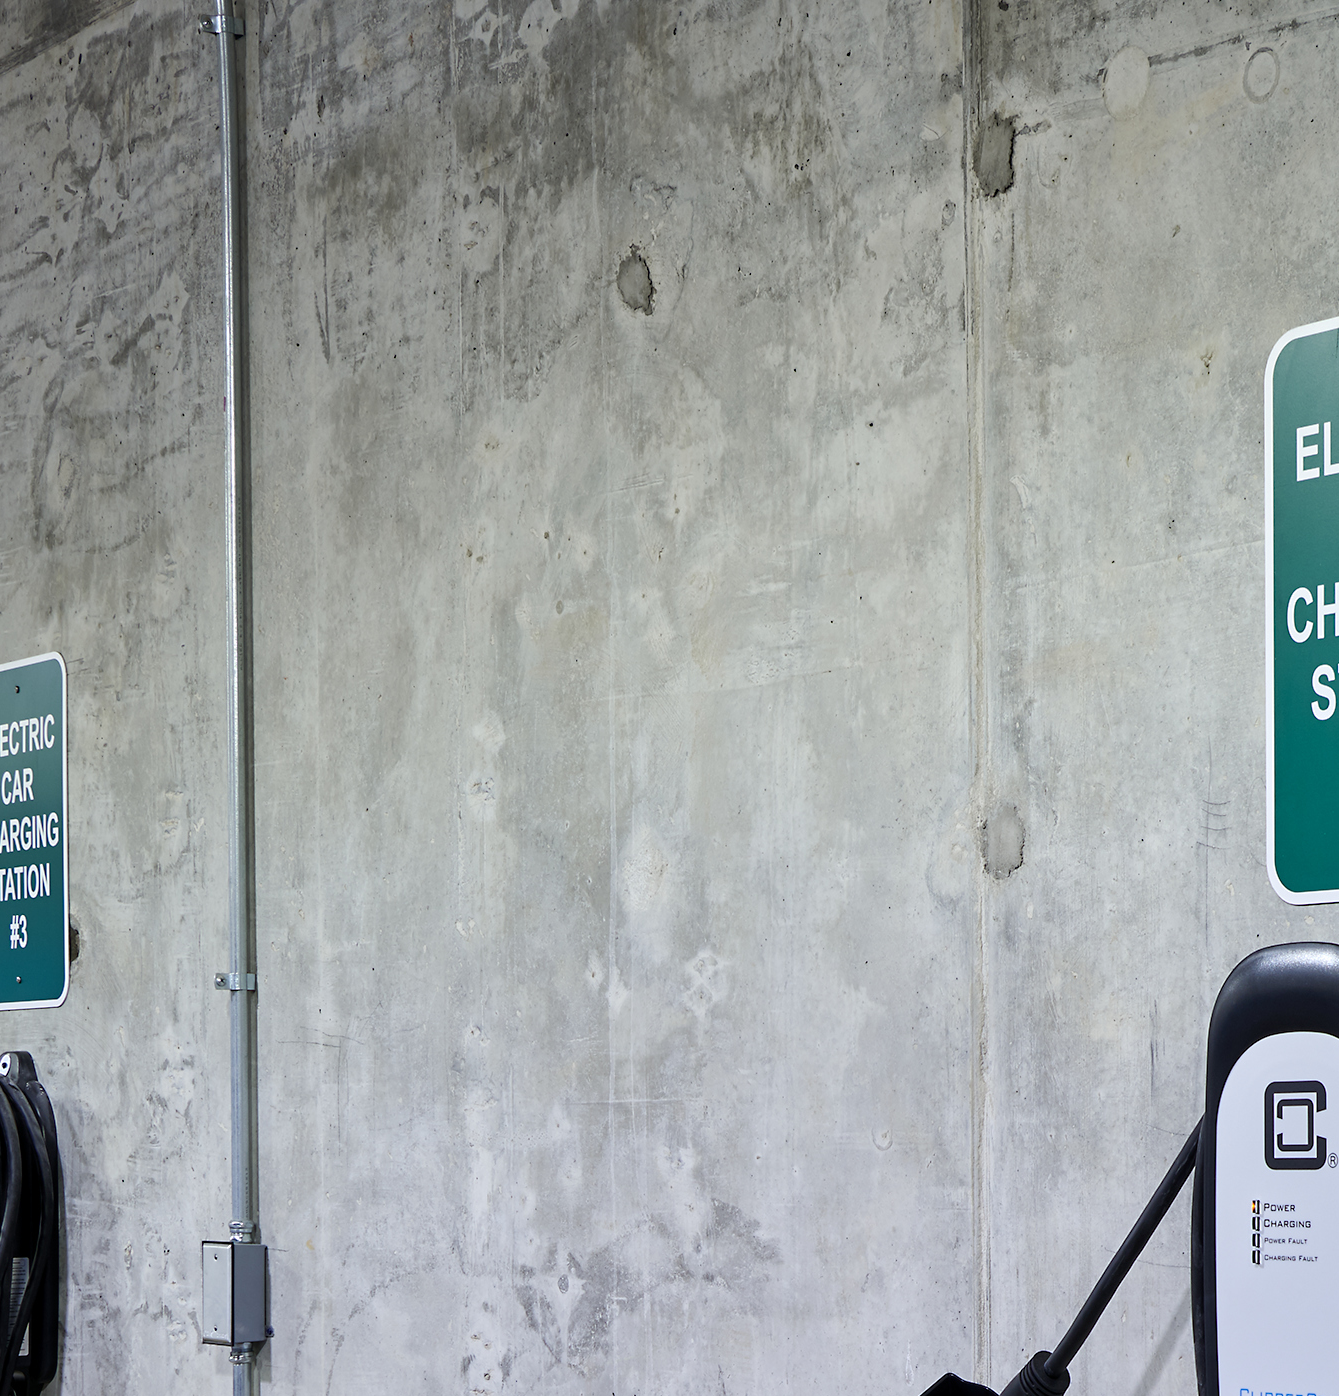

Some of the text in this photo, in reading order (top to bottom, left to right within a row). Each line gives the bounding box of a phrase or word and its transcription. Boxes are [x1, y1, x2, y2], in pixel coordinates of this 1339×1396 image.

[1, 767, 35, 805] CAR
[9, 914, 28, 949] #3
[1263, 1202, 1296, 1212] POWER
[1263, 1218, 1312, 1229] CHARGING
[1264, 1237, 1308, 1245] POWER FAULT
[1264, 1254, 1297, 1262] CHARGING
